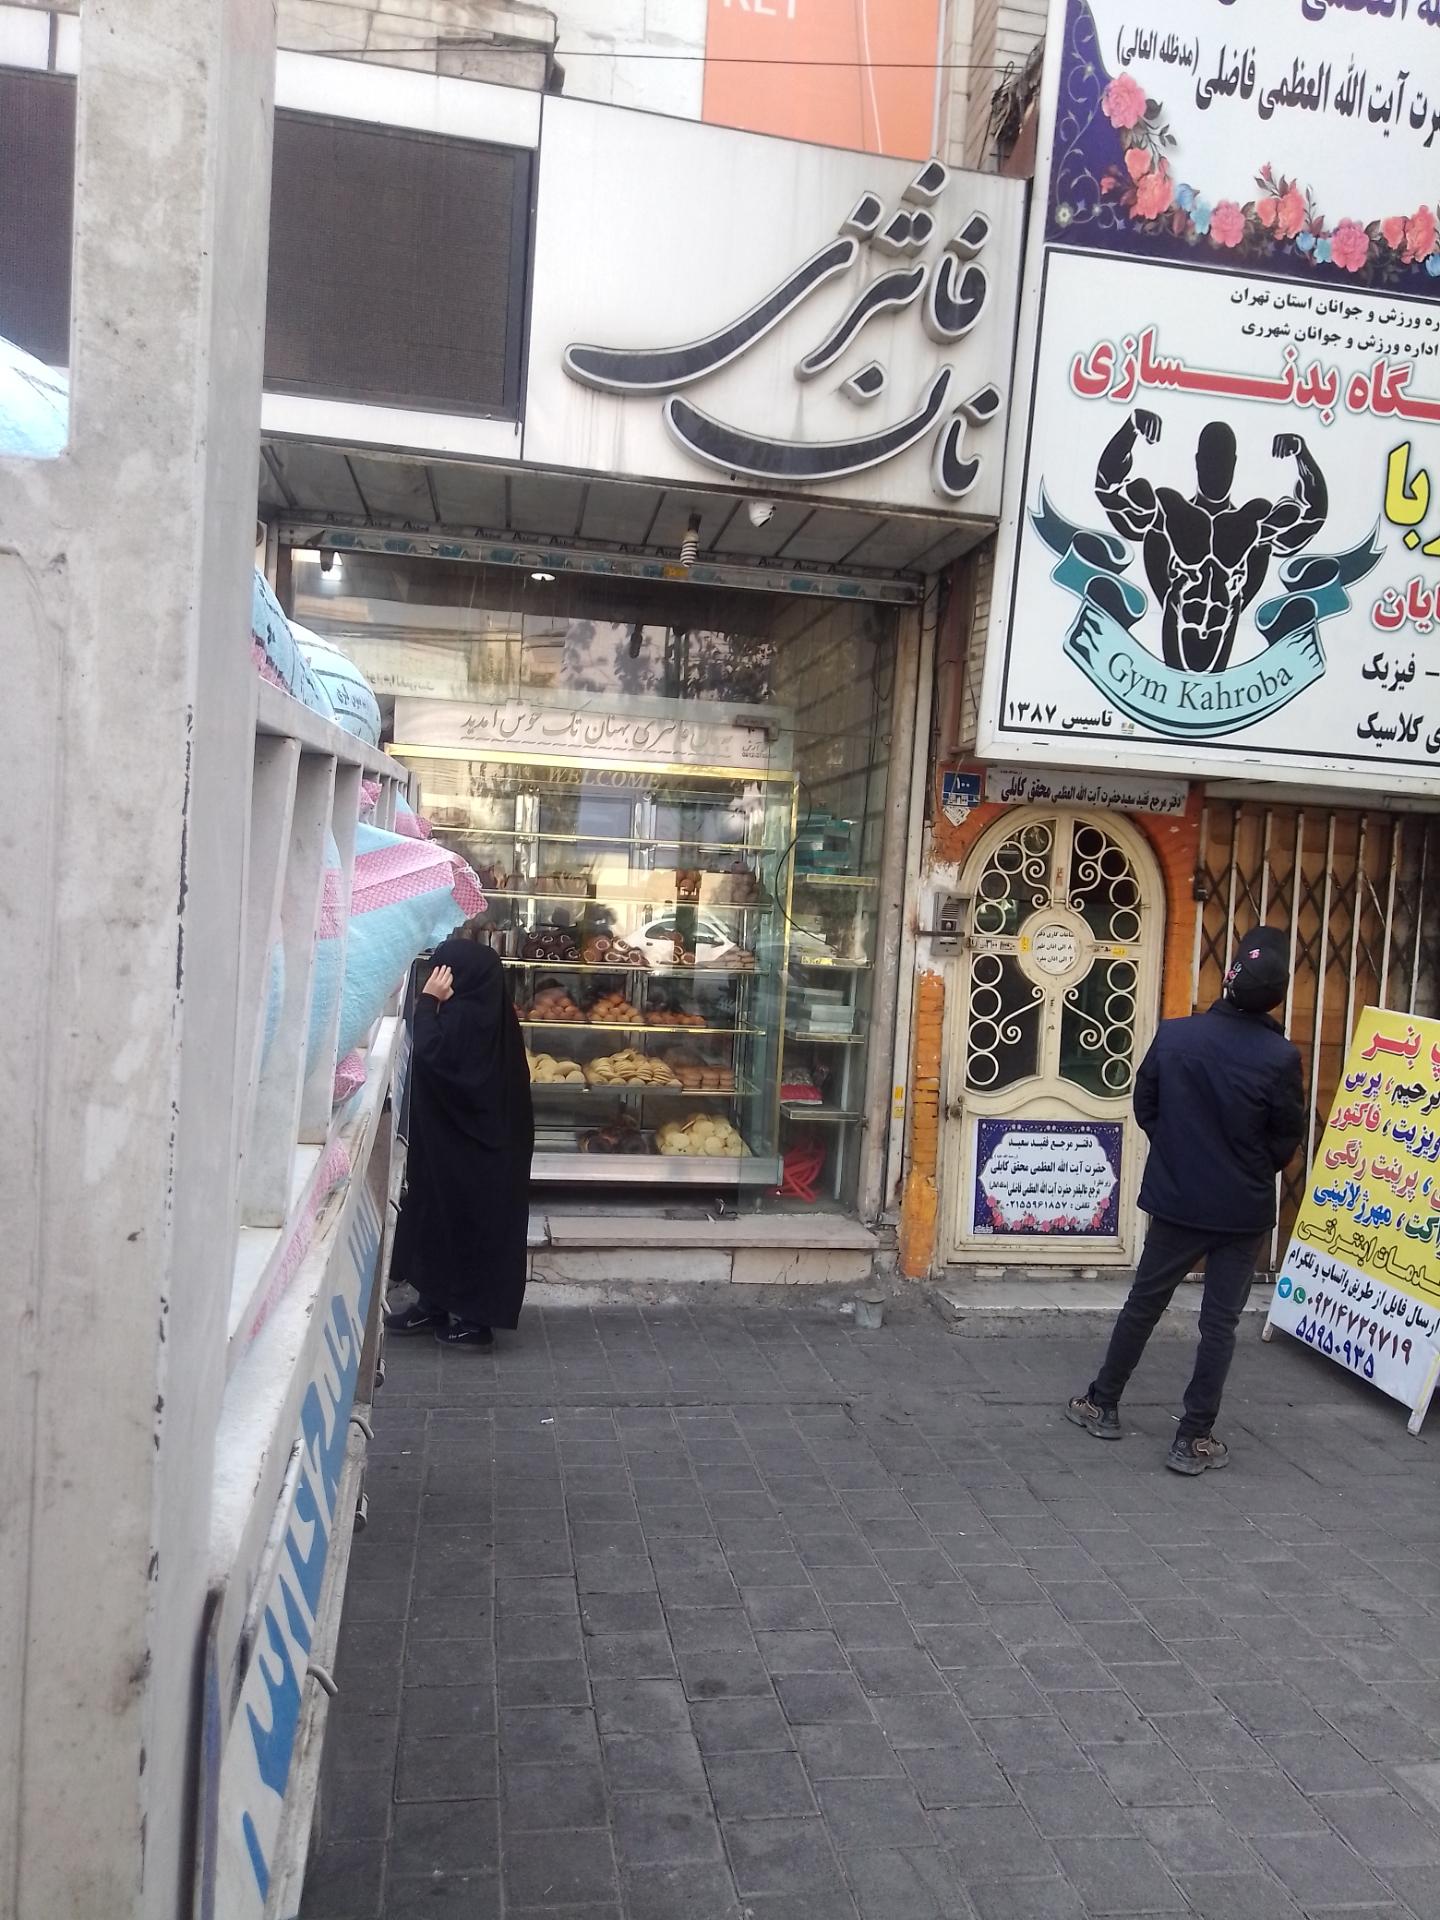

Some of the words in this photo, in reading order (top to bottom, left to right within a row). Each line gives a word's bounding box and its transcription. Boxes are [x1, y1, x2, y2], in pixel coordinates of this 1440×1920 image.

[1195, 44, 1256, 110] فاضلی
[1258, 56, 1332, 120] العظمی
[1334, 52, 1366, 119] الله
[1368, 70, 1410, 138] آیت
[1230, 288, 1270, 307] تهران
[1273, 294, 1312, 311] استان
[1314, 299, 1363, 321] جوانان
[1365, 309, 1376, 323] و
[1378, 308, 1421, 329] ورزش
[1241, 322, 1291, 339] شهرری
[1294, 327, 1341, 347] جوانان
[1346, 337, 1354, 349] و
[1357, 333, 1400, 355] ورزش
[1404, 341, 1439, 358] اداره
[1073, 329, 1338, 425] بدنسازی
[1108, 653, 1168, 703] Gym
[1178, 667, 1294, 711] Kahroba
[1362, 652, 1416, 691] فیزیک
[1009, 701, 1057, 724] ۱۳۸۷
[1062, 709, 1112, 730] تاسیس
[1357, 711, 1424, 747] کلاسیک
[1330, 1104, 1380, 1129] فاکتور
[1009, 1138, 1029, 1150] سعید
[1050, 1140, 1074, 1151] مرجع
[1074, 1137, 1093, 1151] دفتر
[990, 1160, 1010, 1175] کابلی
[1010, 1160, 1029, 1175] محقق
[1030, 1161, 1056, 1175] العظمی
[1057, 1159, 1069, 1173] الله
[1069, 1160, 1084, 1176] آیت
[1084, 1162, 1106, 1176] حضرت
[1371, 1155, 1418, 1200] پرینت
[1288, 1246, 1316, 1270] تلگرام
[1320, 1263, 1350, 1294] واتساپ
[1348, 1279, 1374, 1302] طریق
[1371, 1290, 1388, 1310] از
[1382, 1296, 1407, 1319] فایل
[1307, 1291, 1413, 1366] ۰۹۲۱۴۷۲۹۷۱۹
[1405, 1304, 1440, 1338] ارسال
[1295, 1314, 1375, 1379] ۵۵۹۵۰۹۳۵
